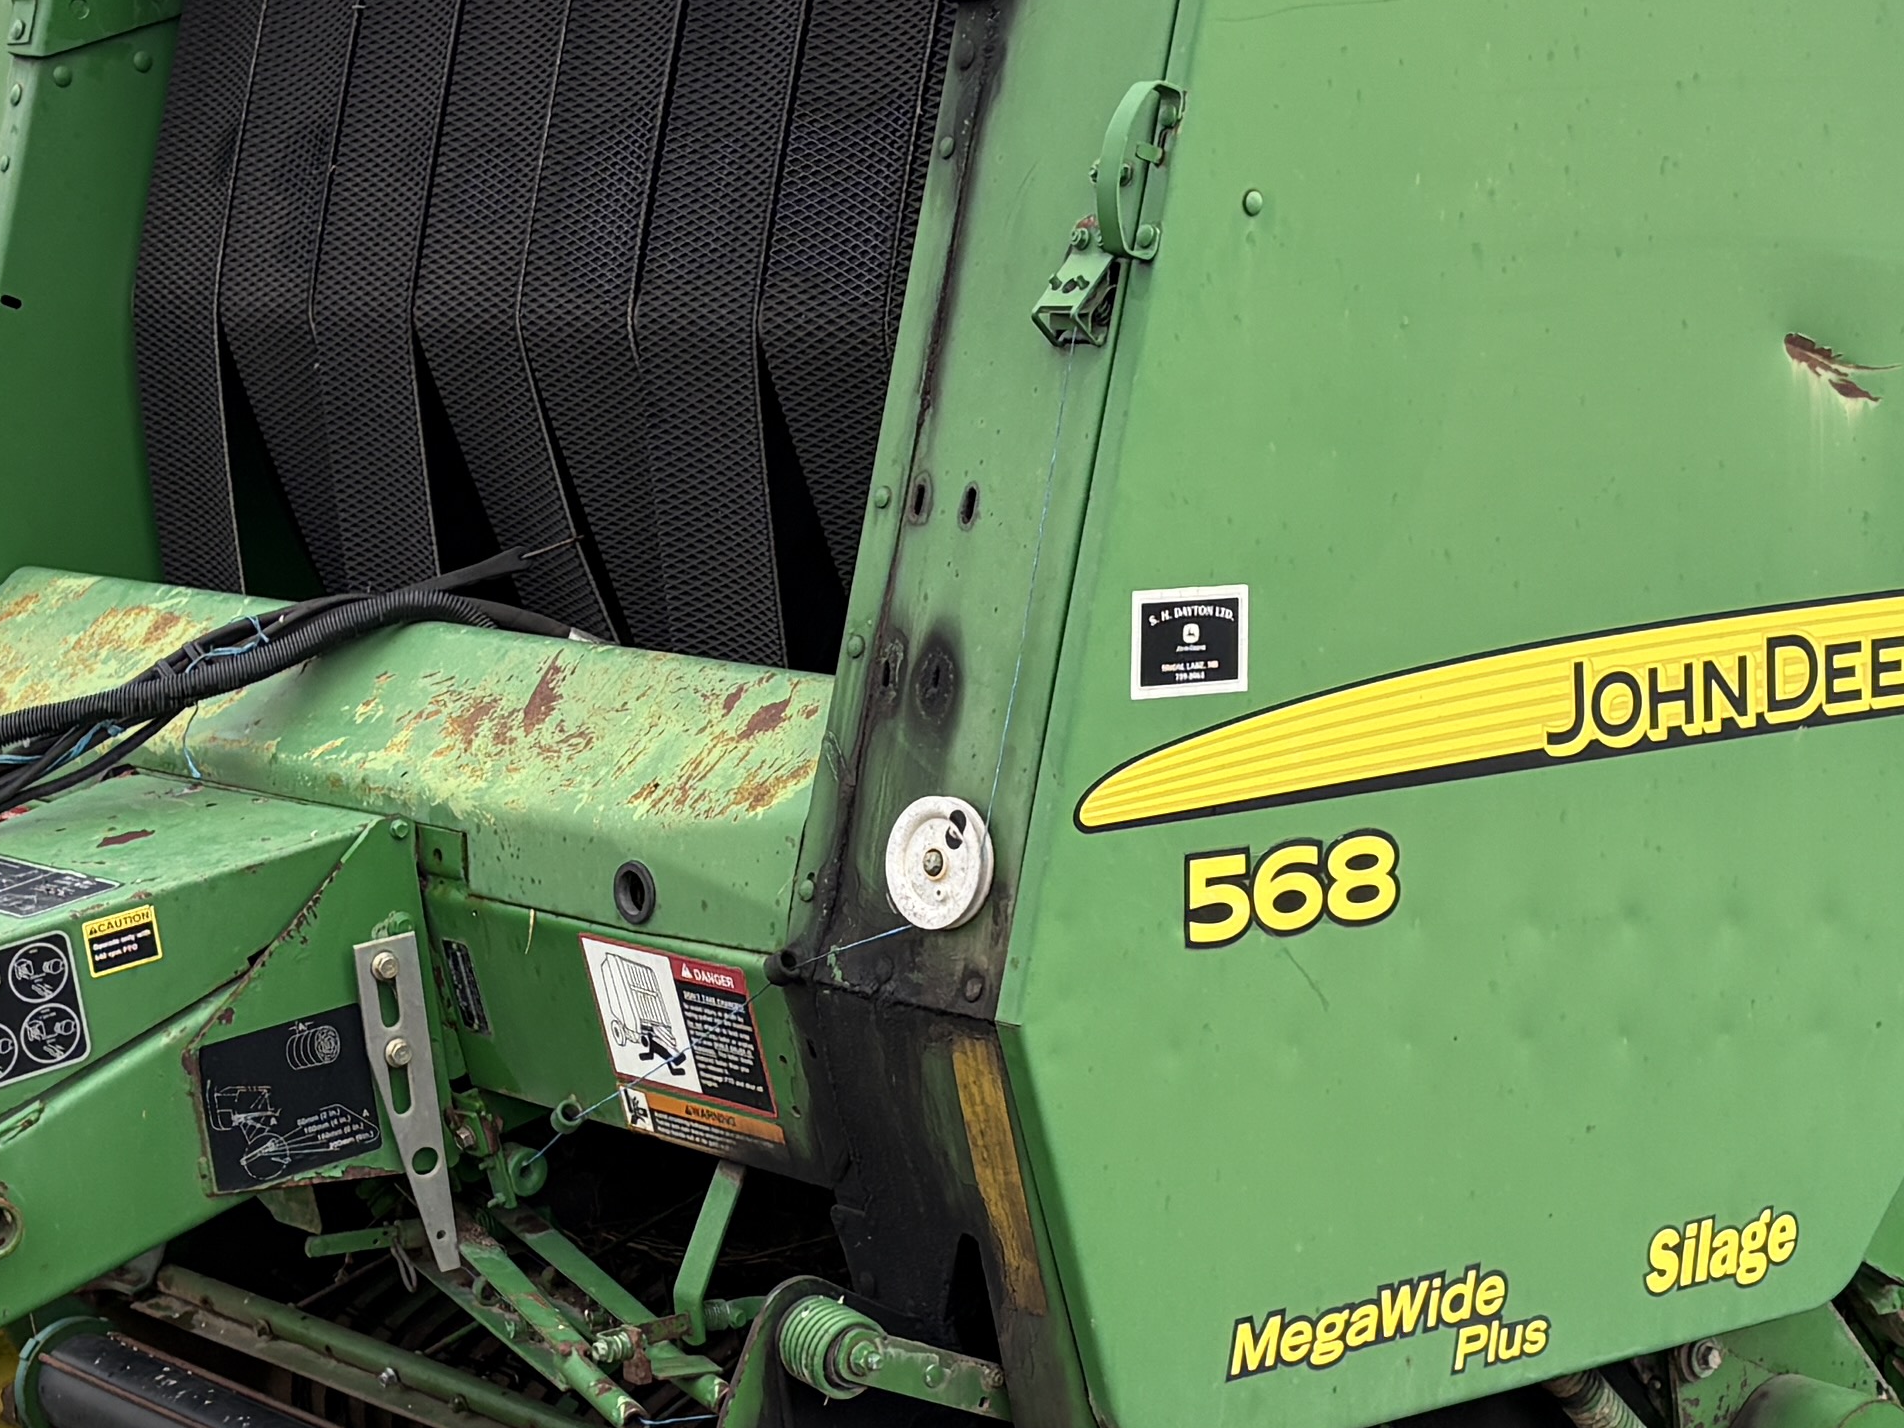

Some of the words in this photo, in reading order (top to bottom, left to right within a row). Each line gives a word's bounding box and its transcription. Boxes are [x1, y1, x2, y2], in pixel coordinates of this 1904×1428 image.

[1174, 605, 1214, 618] DAYTON
[1546, 655, 1748, 746] JOHN
[98, 911, 149, 933] CAUTION
[1184, 828, 1400, 949] 568
[693, 968, 735, 989] DANGER
[1643, 1206, 1798, 1298] Silage
[1226, 1262, 1508, 1382] MegaWide
[1451, 1316, 1551, 1376] Plus
